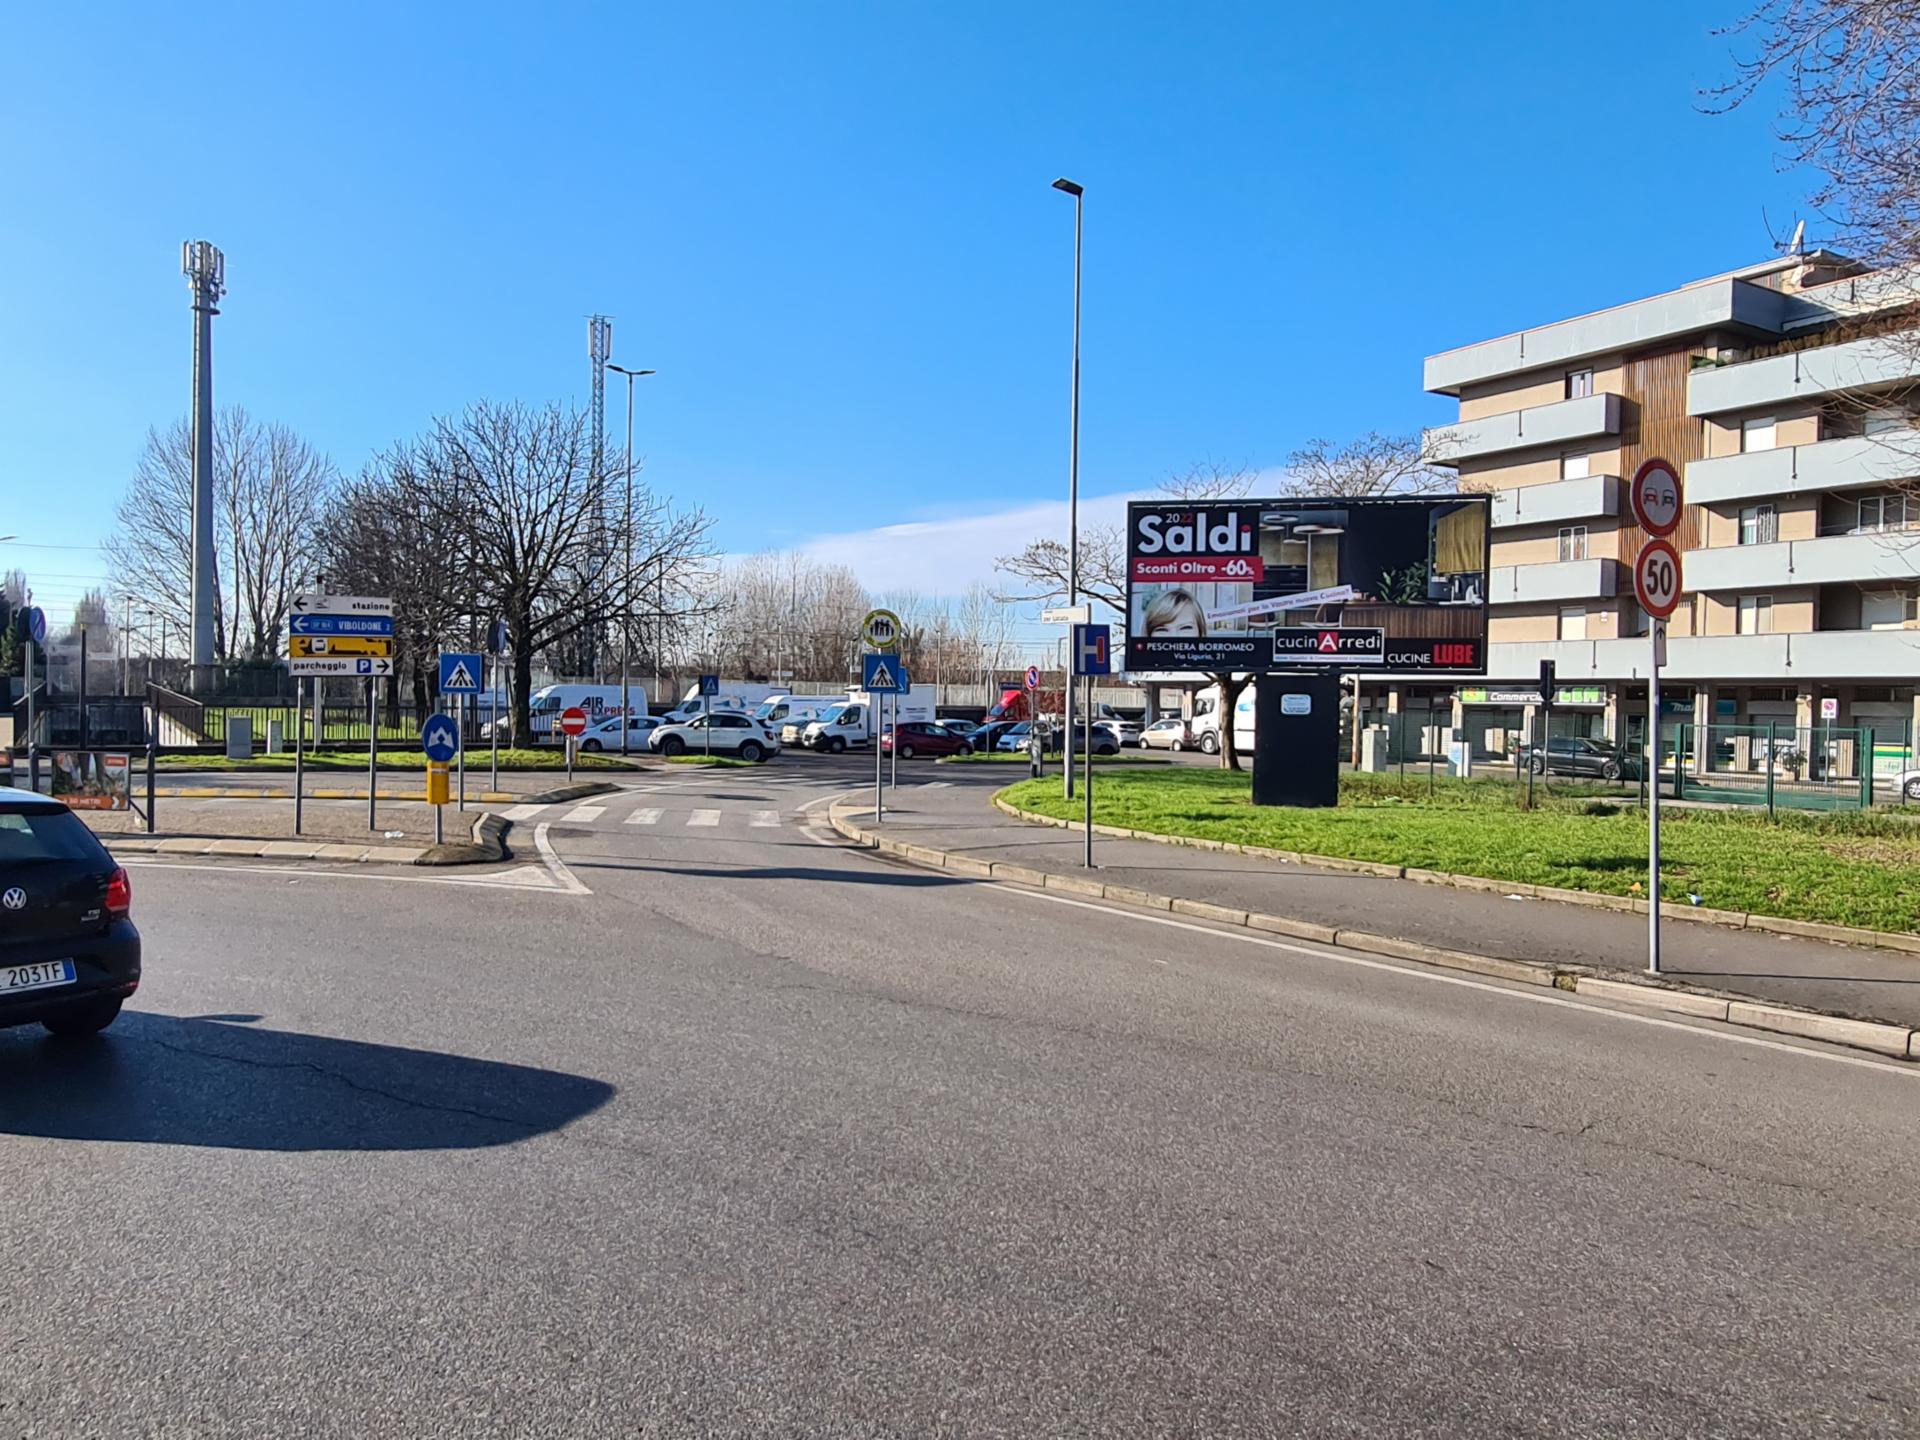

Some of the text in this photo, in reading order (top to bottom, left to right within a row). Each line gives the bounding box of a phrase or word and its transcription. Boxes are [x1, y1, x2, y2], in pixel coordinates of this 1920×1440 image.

[1166, 513, 1194, 524] 2022
[1137, 511, 1252, 553] Saldi
[1136, 562, 1178, 574] Sconti
[1180, 562, 1216, 574] Oltre
[1645, 558, 1673, 597] 50
[352, 602, 390, 610] stazione
[338, 621, 382, 632] VIBOLDONE
[1146, 642, 1255, 652] PESCHIERA BORROMEO
[1276, 632, 1381, 652] cucinArredi
[1387, 653, 1431, 664] CUCINE
[1432, 643, 1474, 664] LUBE
[293, 661, 347, 672] parcheggio
[359, 660, 369, 672] P
[579, 696, 604, 708] AIR
[8, 962, 61, 987] 203TF
